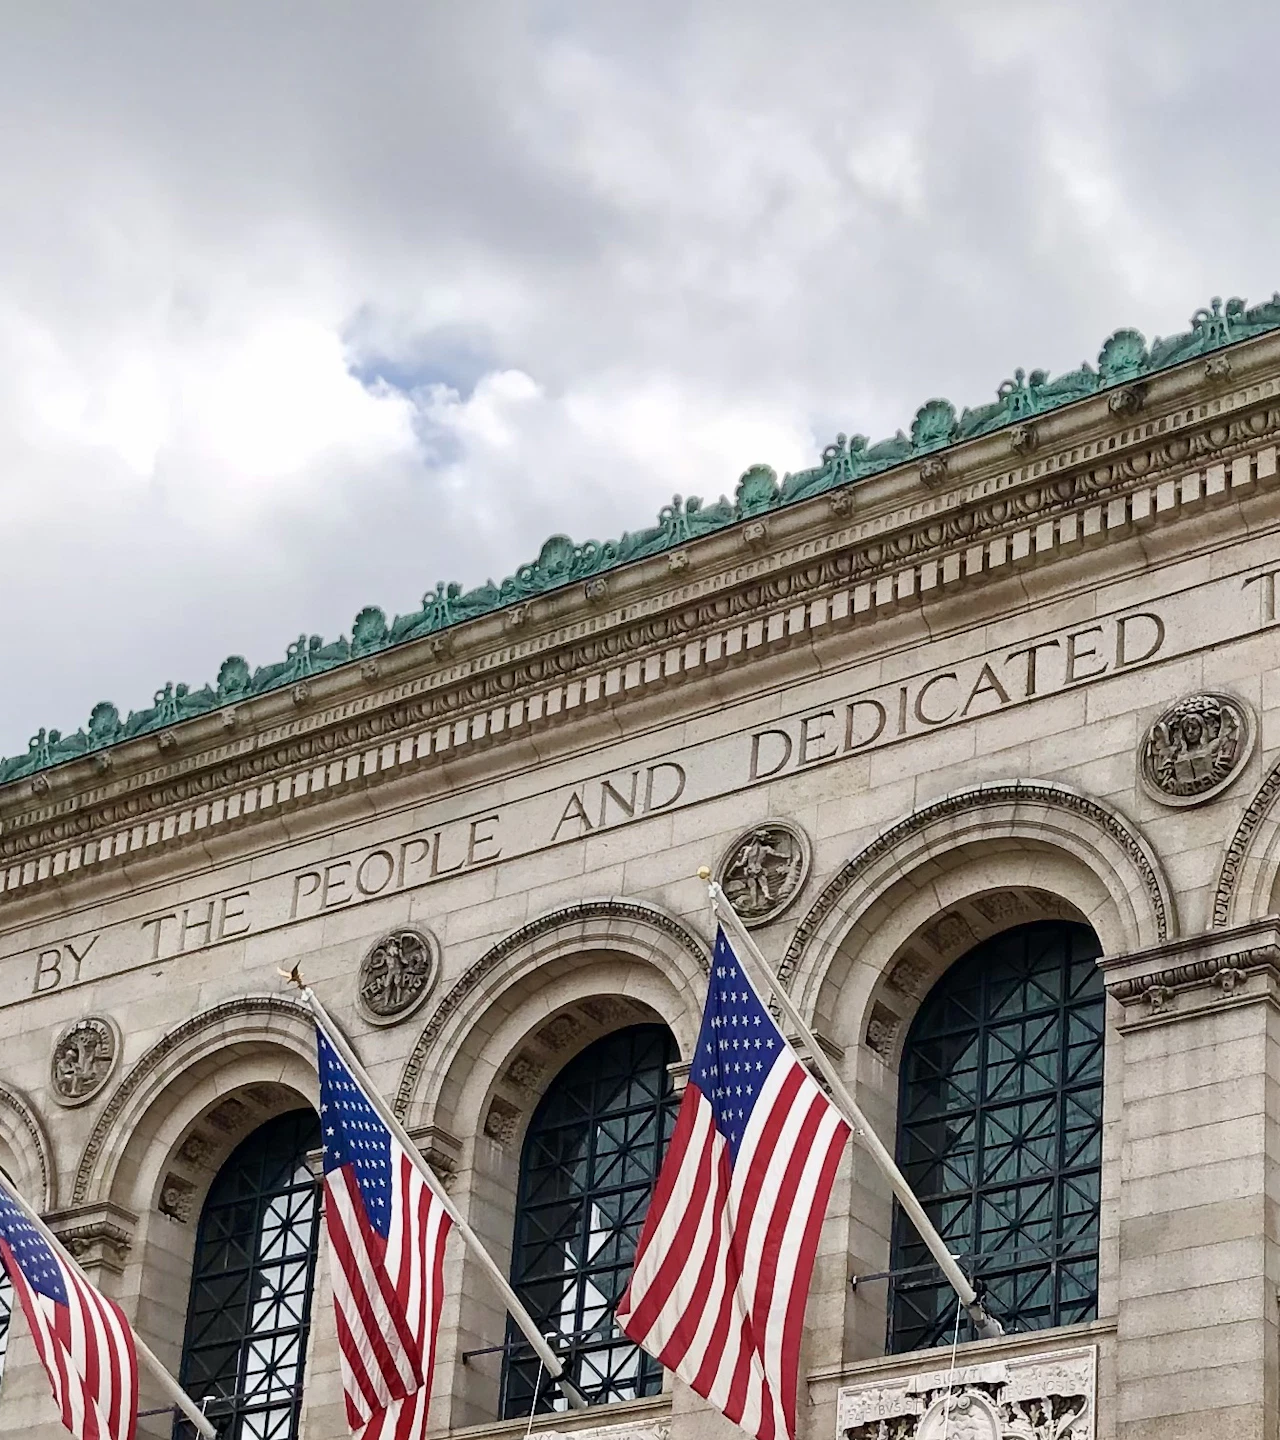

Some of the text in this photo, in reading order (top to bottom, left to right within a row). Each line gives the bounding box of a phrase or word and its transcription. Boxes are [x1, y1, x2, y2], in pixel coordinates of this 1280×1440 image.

[32, 936, 100, 993] BY
[141, 891, 251, 959] THE
[290, 814, 502, 919] PEOPLE
[550, 761, 686, 842] AND
[748, 612, 1166, 782] DEDICATED
